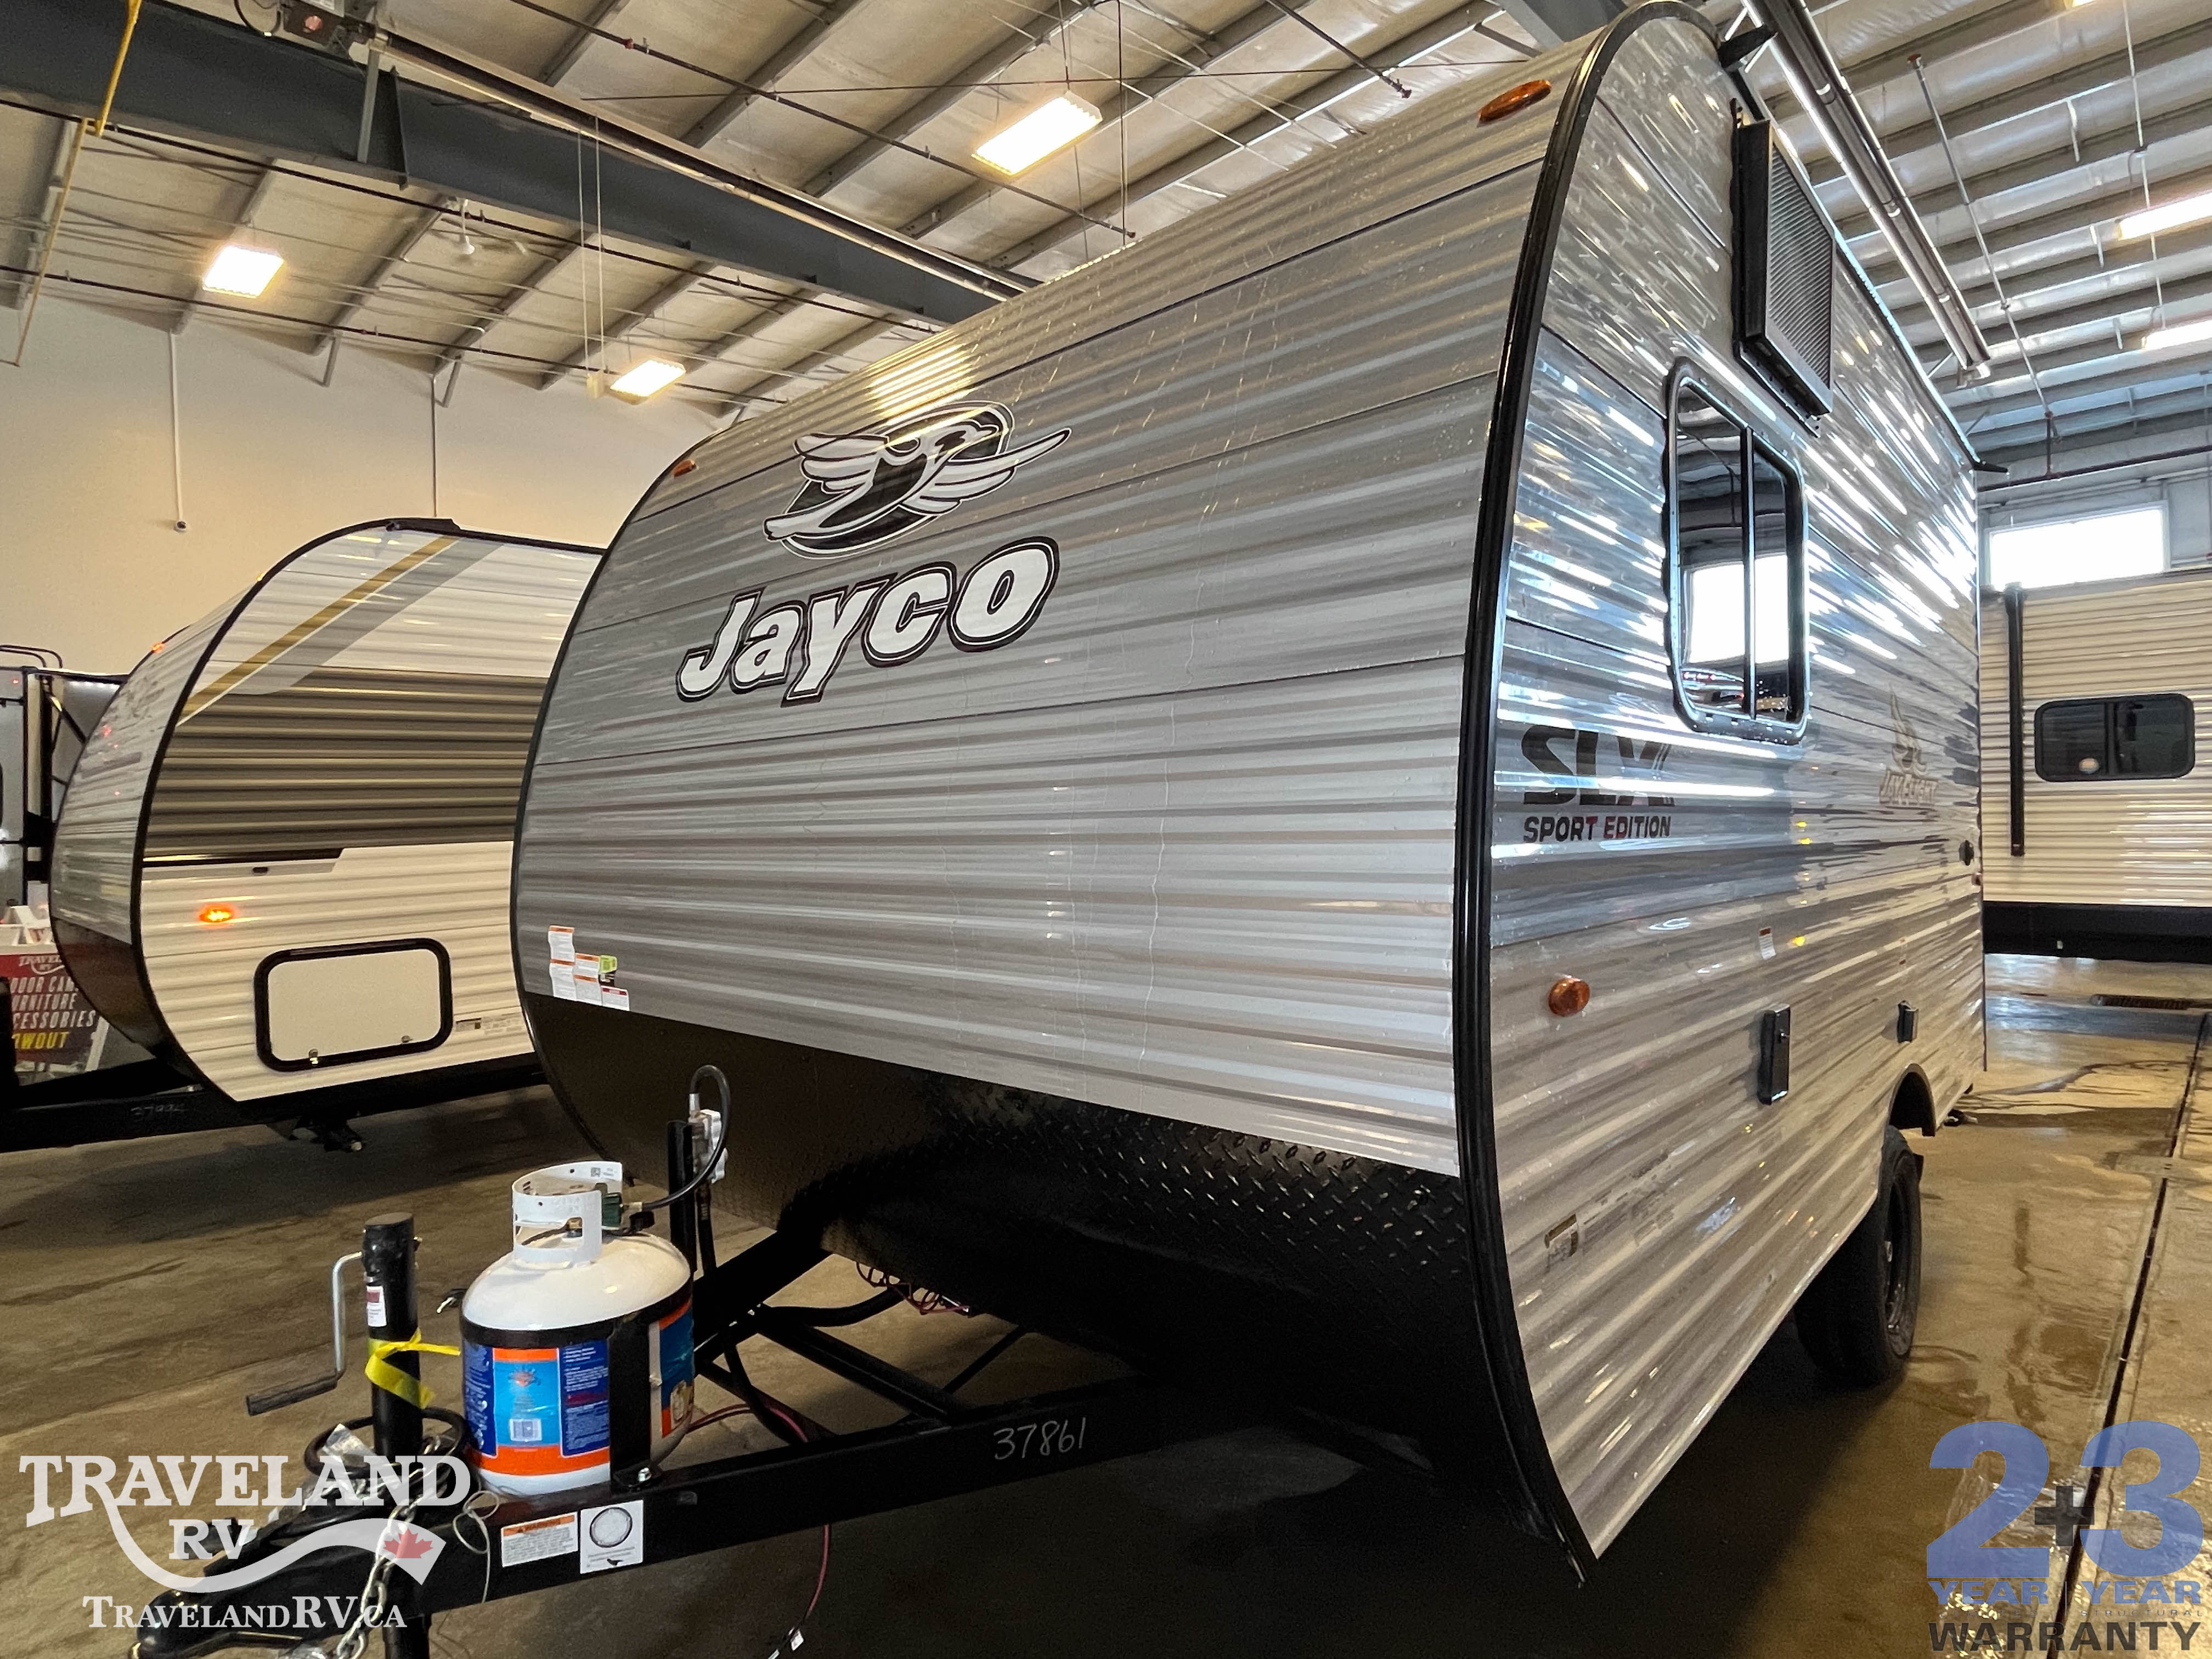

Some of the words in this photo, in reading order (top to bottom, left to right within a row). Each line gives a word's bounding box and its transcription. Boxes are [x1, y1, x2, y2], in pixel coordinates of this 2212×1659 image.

[675, 536, 1059, 708] Jayco
[1523, 816, 1598, 843] SPORT
[1603, 816, 1672, 839] EDITION
[993, 1417, 1086, 1460] 37861
